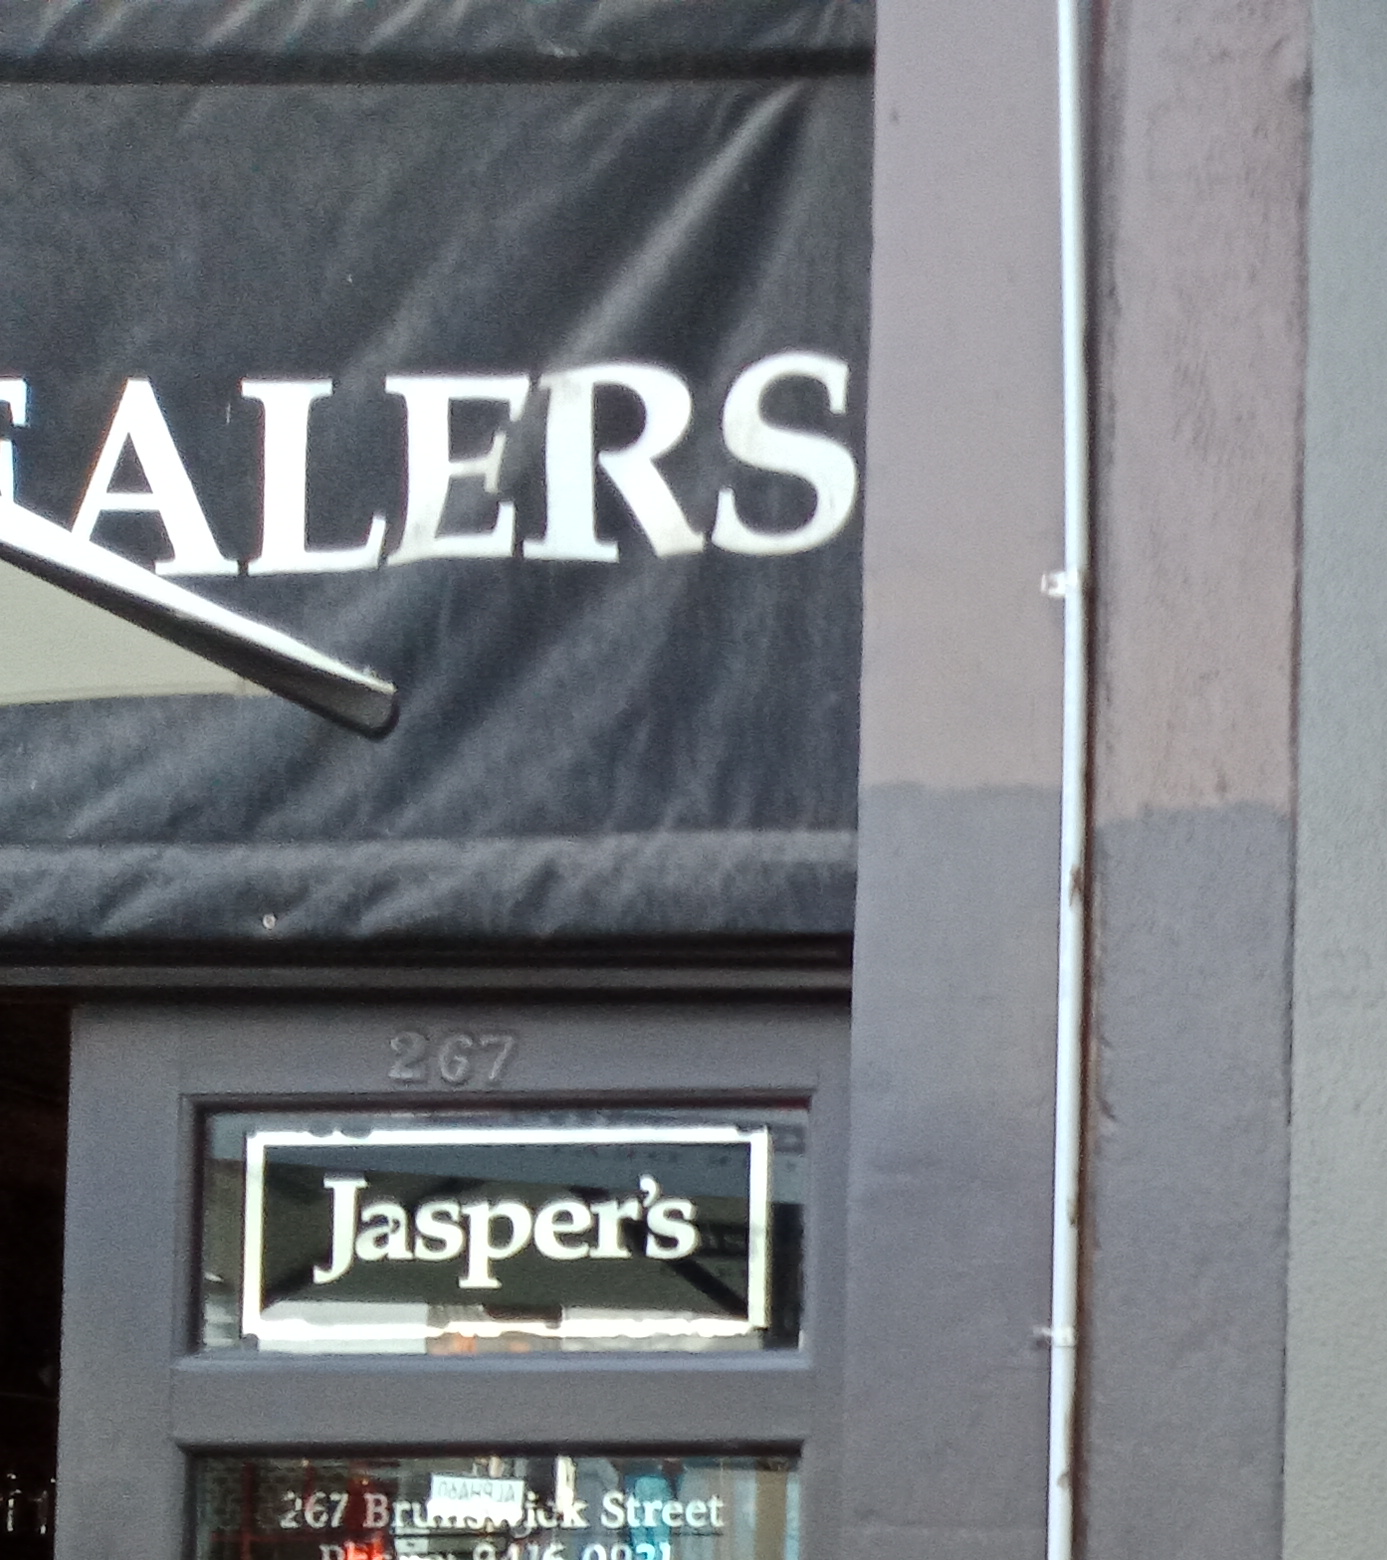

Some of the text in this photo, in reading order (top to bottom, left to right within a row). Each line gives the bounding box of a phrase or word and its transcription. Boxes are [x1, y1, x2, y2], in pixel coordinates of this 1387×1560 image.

[0, 348, 859, 577] ALERS
[386, 1032, 518, 1086] 267
[313, 1174, 698, 1290] Jasper's
[279, 1492, 349, 1530] 267
[600, 1490, 725, 1531] Street
